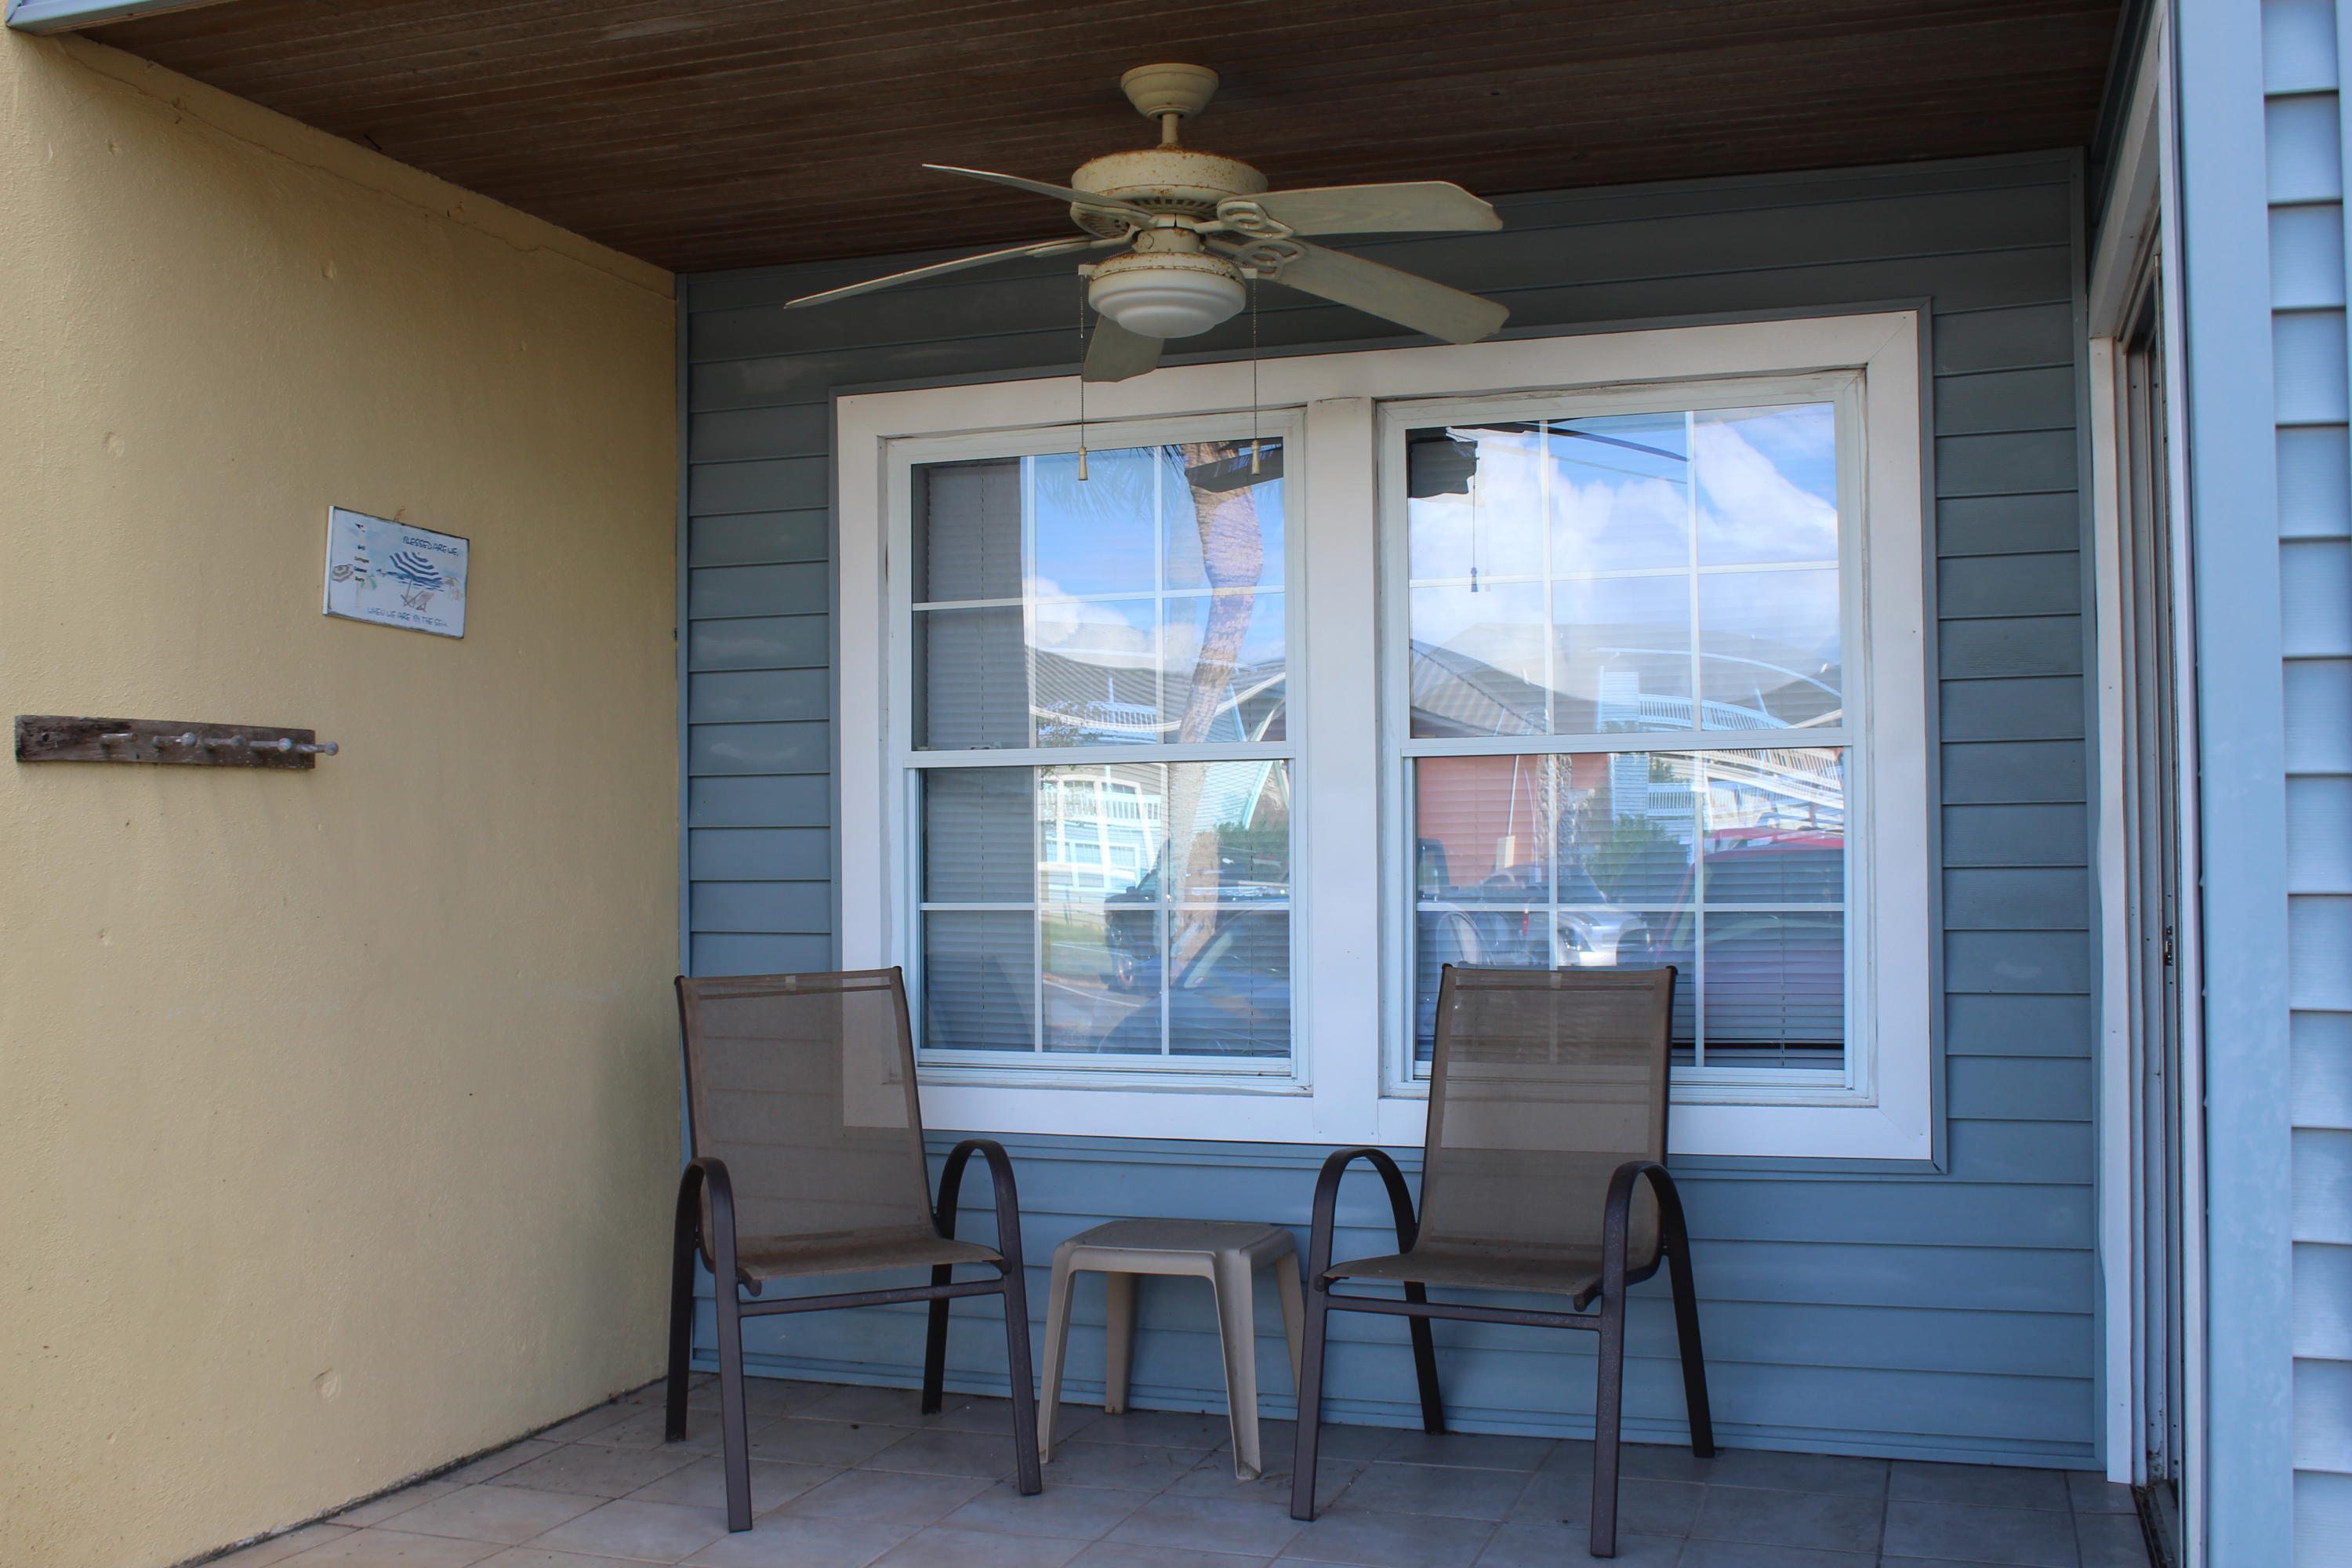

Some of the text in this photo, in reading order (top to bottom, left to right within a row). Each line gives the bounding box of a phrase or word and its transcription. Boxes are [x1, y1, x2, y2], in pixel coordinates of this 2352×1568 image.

[403, 536, 432, 550] BLESSED
[433, 543, 447, 554] ARE
[368, 608, 385, 616] WHEN
[397, 612, 411, 621] ARE
[422, 616, 434, 625] THE
